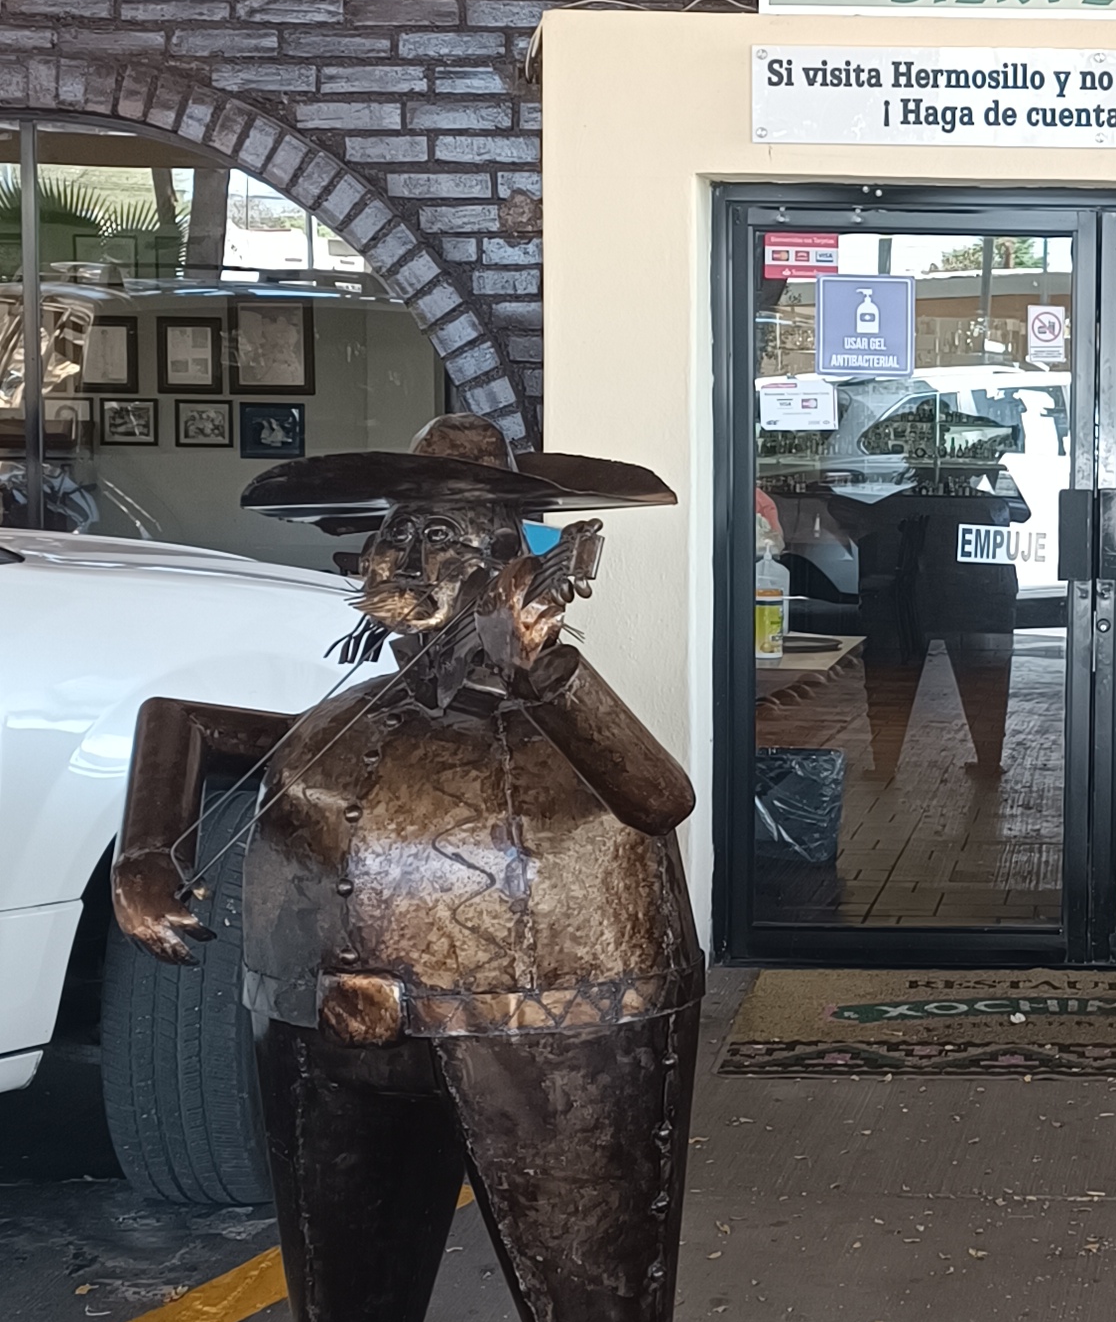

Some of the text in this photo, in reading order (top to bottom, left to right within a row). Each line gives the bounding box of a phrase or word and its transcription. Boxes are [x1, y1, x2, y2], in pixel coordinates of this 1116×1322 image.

[767, 59, 795, 87] Si
[803, 60, 883, 88] visita
[892, 61, 1046, 90] Hermosillo
[1053, 70, 1071, 98] y
[1079, 70, 1113, 91] no
[900, 98, 974, 134] Haga
[984, 99, 1018, 127] de
[844, 336, 887, 351] USAR GEL
[830, 354, 900, 369] ANTIBACTERIAL
[960, 528, 1047, 562] EMPUJE
